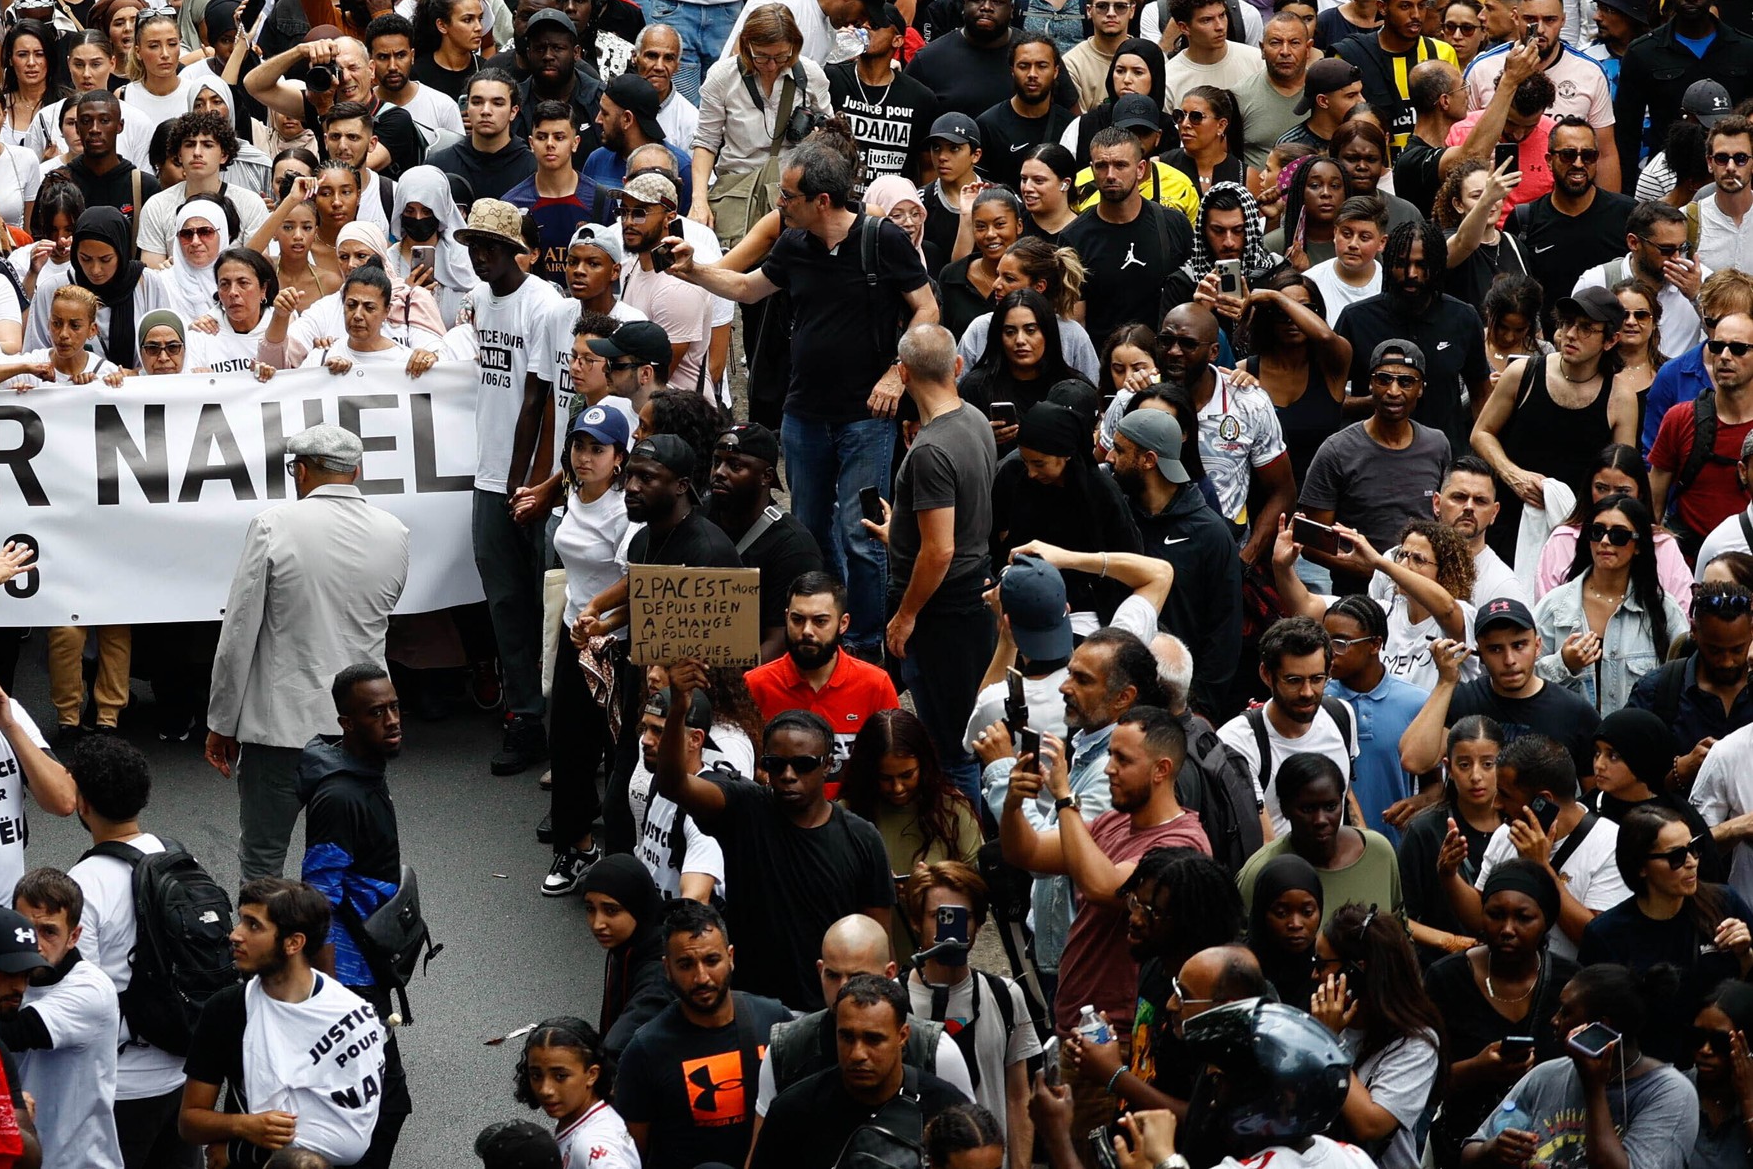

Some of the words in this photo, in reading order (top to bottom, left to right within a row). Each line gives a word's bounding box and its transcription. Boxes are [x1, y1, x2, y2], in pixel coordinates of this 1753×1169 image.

[843, 95, 882, 115] Justice
[886, 104, 914, 119] pour
[868, 150, 905, 166] justice
[211, 359, 250, 373] JUSTIC
[480, 349, 509, 369] AHEL
[482, 372, 511, 389] /06/23
[94, 393, 476, 506] NAHEL
[694, 577, 732, 598] EST
[642, 600, 697, 615] DEPUIS
[643, 617, 655, 629] A
[641, 630, 657, 640] LA
[662, 628, 711, 640] POLICE
[635, 642, 671, 662] TUE
[678, 644, 702, 657] NOS
[704, 645, 731, 656] VIES
[335, 1030, 379, 1069] POUR
